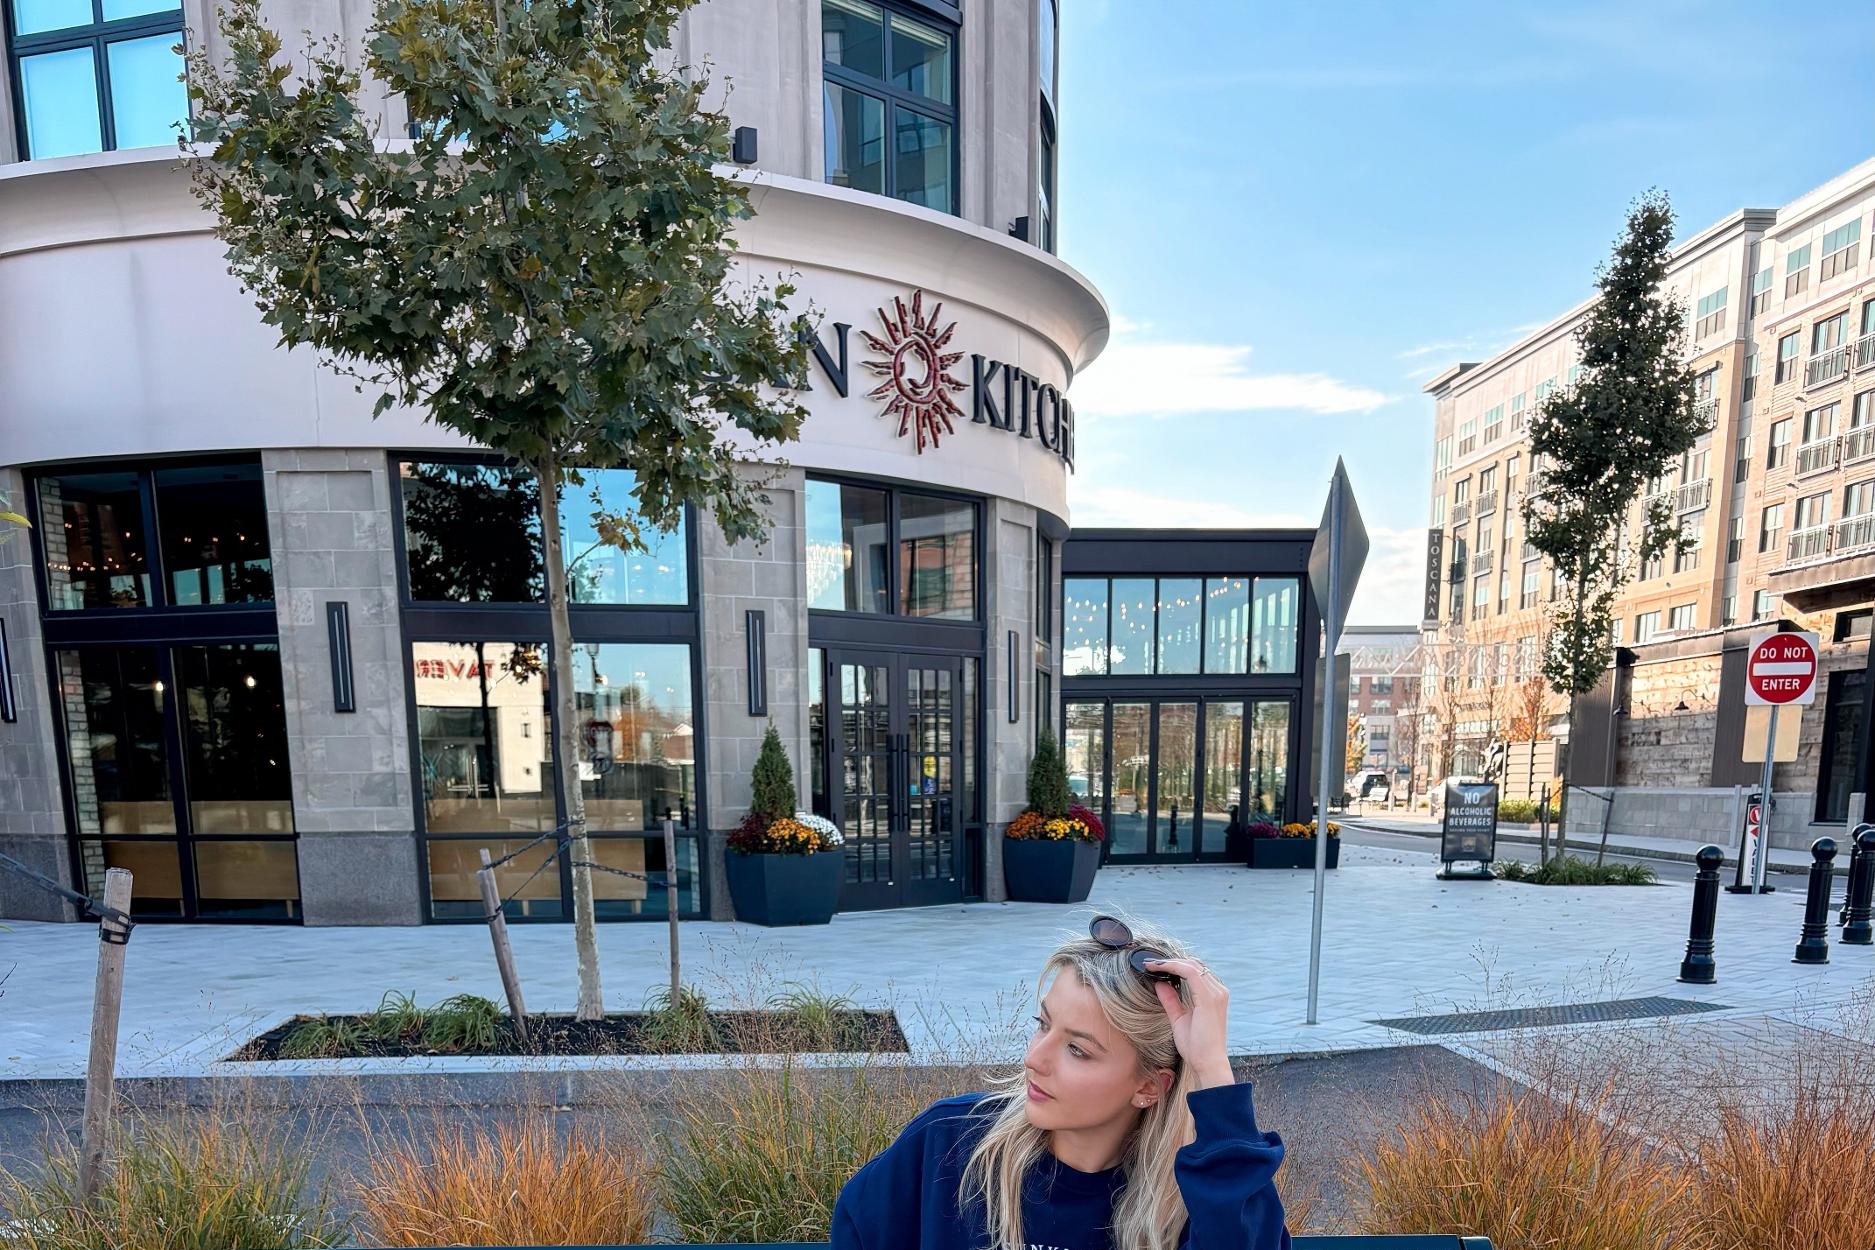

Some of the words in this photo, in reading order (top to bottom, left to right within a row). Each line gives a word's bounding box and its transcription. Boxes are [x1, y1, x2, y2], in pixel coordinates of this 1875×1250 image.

[1428, 533, 1440, 616] TOSCANA
[1760, 647, 1777, 659] DO
[1783, 647, 1808, 659] NOT
[1761, 678, 1800, 691] ENTER
[1464, 792, 1480, 804] NO
[1450, 807, 1492, 816] ALCOHOLIC
[1449, 817, 1491, 826] BEVERAGES
